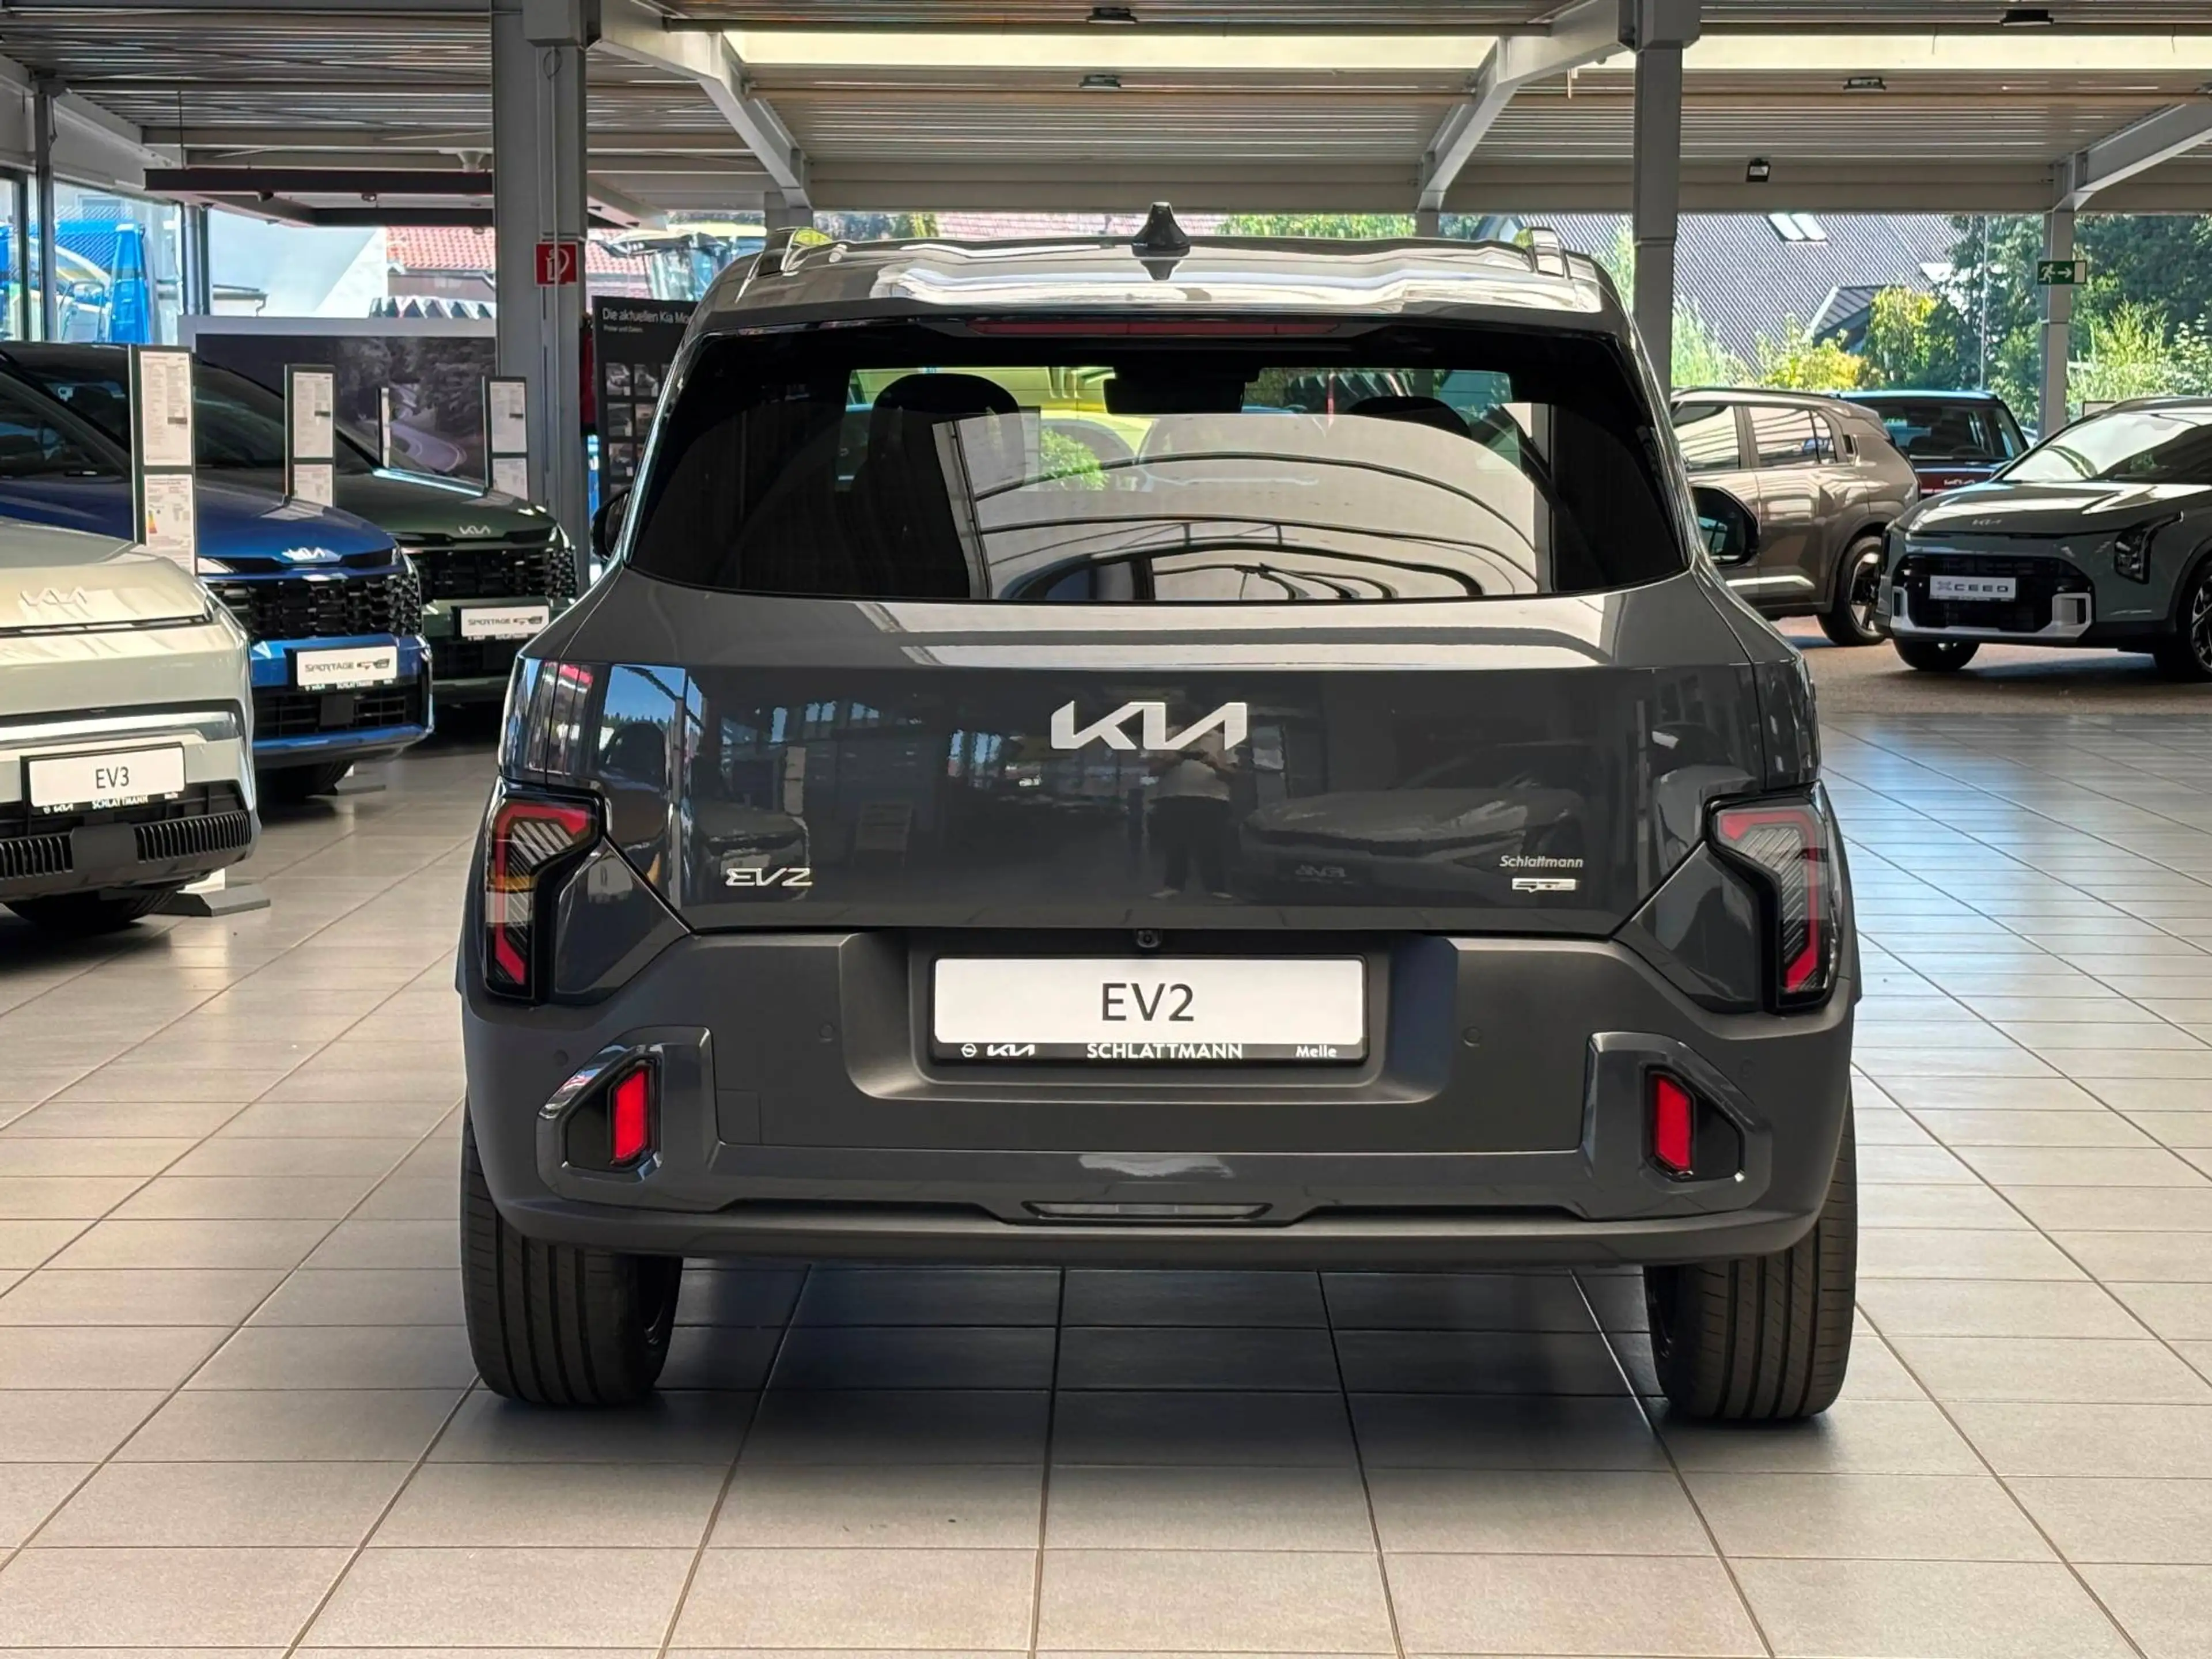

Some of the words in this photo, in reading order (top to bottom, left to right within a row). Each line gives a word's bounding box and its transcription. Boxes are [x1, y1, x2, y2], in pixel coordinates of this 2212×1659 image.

[603, 307, 618, 321] Die
[619, 309, 658, 323] aktuellen
[659, 311, 674, 324] Kia
[459, 525, 491, 535] KIA
[1937, 581, 2009, 593] XCEED
[468, 618, 511, 626] SPORTAGE
[305, 662, 354, 672] SPORTAGE
[1051, 700, 1248, 751] KIA
[95, 766, 130, 789] EV3
[92, 796, 149, 810] SCHLATTMANN
[1499, 854, 1584, 868] Schlattmann
[725, 868, 813, 887] EV2
[1102, 982, 1194, 1022] EV2
[987, 1044, 1035, 1057] KIA
[1086, 1043, 1243, 1059] SCHLATTMANN
[1296, 1044, 1338, 1058] Melle
